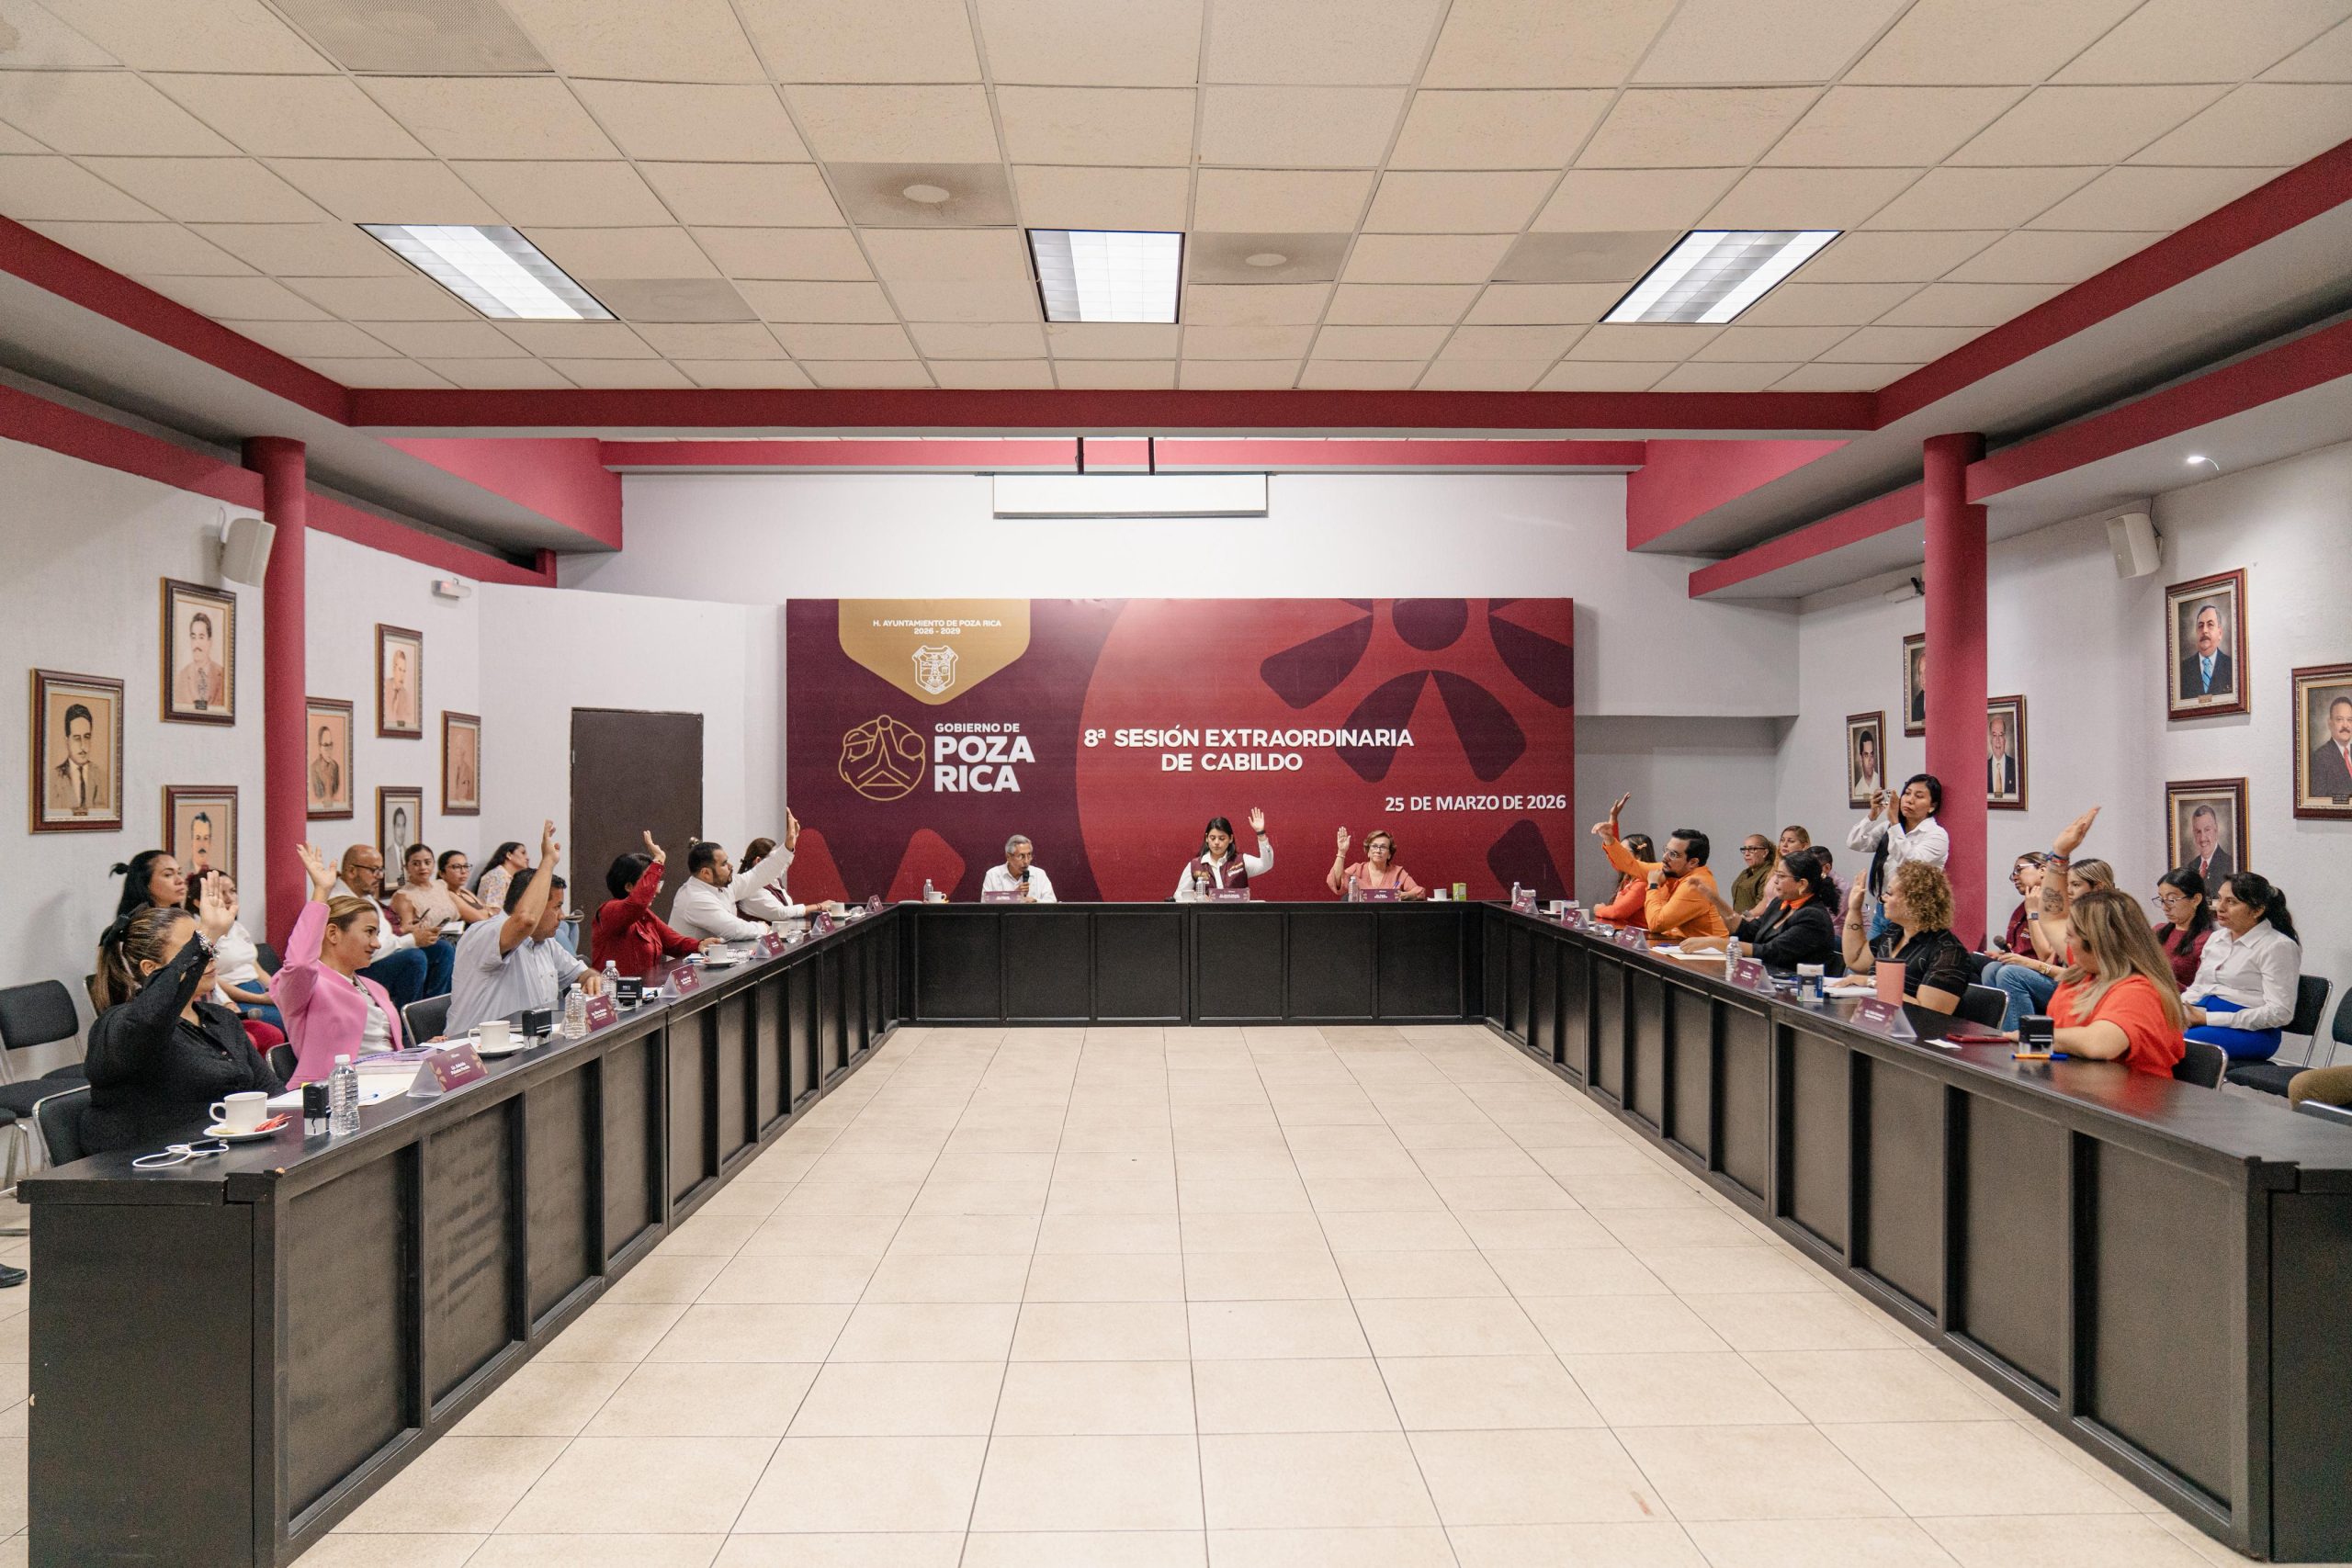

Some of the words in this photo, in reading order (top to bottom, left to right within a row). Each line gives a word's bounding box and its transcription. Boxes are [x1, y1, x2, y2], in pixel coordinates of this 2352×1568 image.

[873, 619, 881, 627] H.
[883, 619, 945, 627] AYUNTAMIENTO
[946, 619, 957, 627] DE
[959, 619, 981, 627] POZA
[983, 619, 1001, 627] RICA
[934, 723, 1001, 733] GOBIERNO
[1003, 723, 1020, 733] DE
[1084, 728, 1106, 747] 8ª
[1114, 724, 1199, 748] SESIÓN
[1205, 728, 1414, 747] EXTRAORDINARIA
[934, 736, 1035, 763] POZA
[1161, 753, 1193, 772] DE
[1201, 752, 1303, 772] CABILDO
[934, 765, 1021, 793] RICA
[1385, 796, 1405, 812] 25
[1411, 796, 1432, 811] DE
[1436, 795, 1499, 811] MARZO
[1503, 795, 1524, 810] DE
[1527, 794, 1566, 809] 2026
